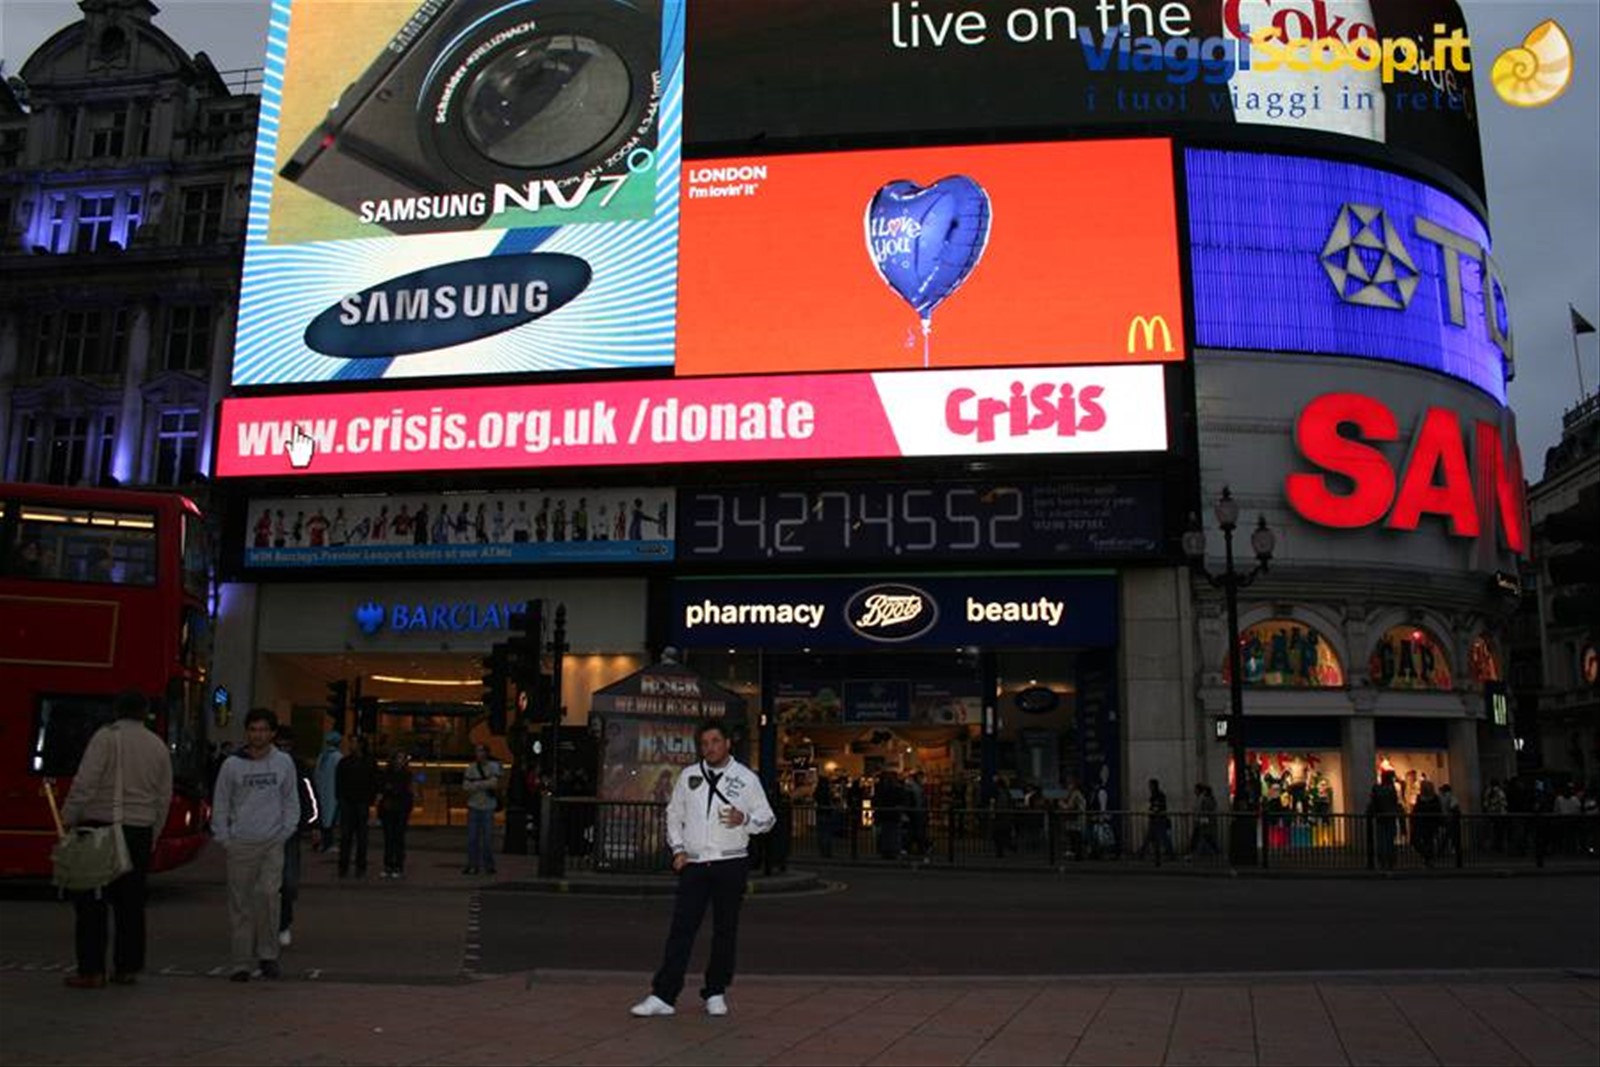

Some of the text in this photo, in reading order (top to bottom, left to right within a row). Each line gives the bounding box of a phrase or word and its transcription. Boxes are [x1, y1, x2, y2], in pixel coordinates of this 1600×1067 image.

[891, 1, 987, 48] live
[1006, 5, 1077, 42] on
[1095, 0, 1192, 37] the
[689, 165, 768, 183] LONDON
[359, 174, 629, 224] SAMSUNG NV7
[339, 280, 550, 326] SAMSUNG
[237, 396, 816, 457] www.crisis.org.uk /donate
[391, 602, 527, 631] BARCLAY
[684, 593, 1065, 629] pharmacy Boots beauty
